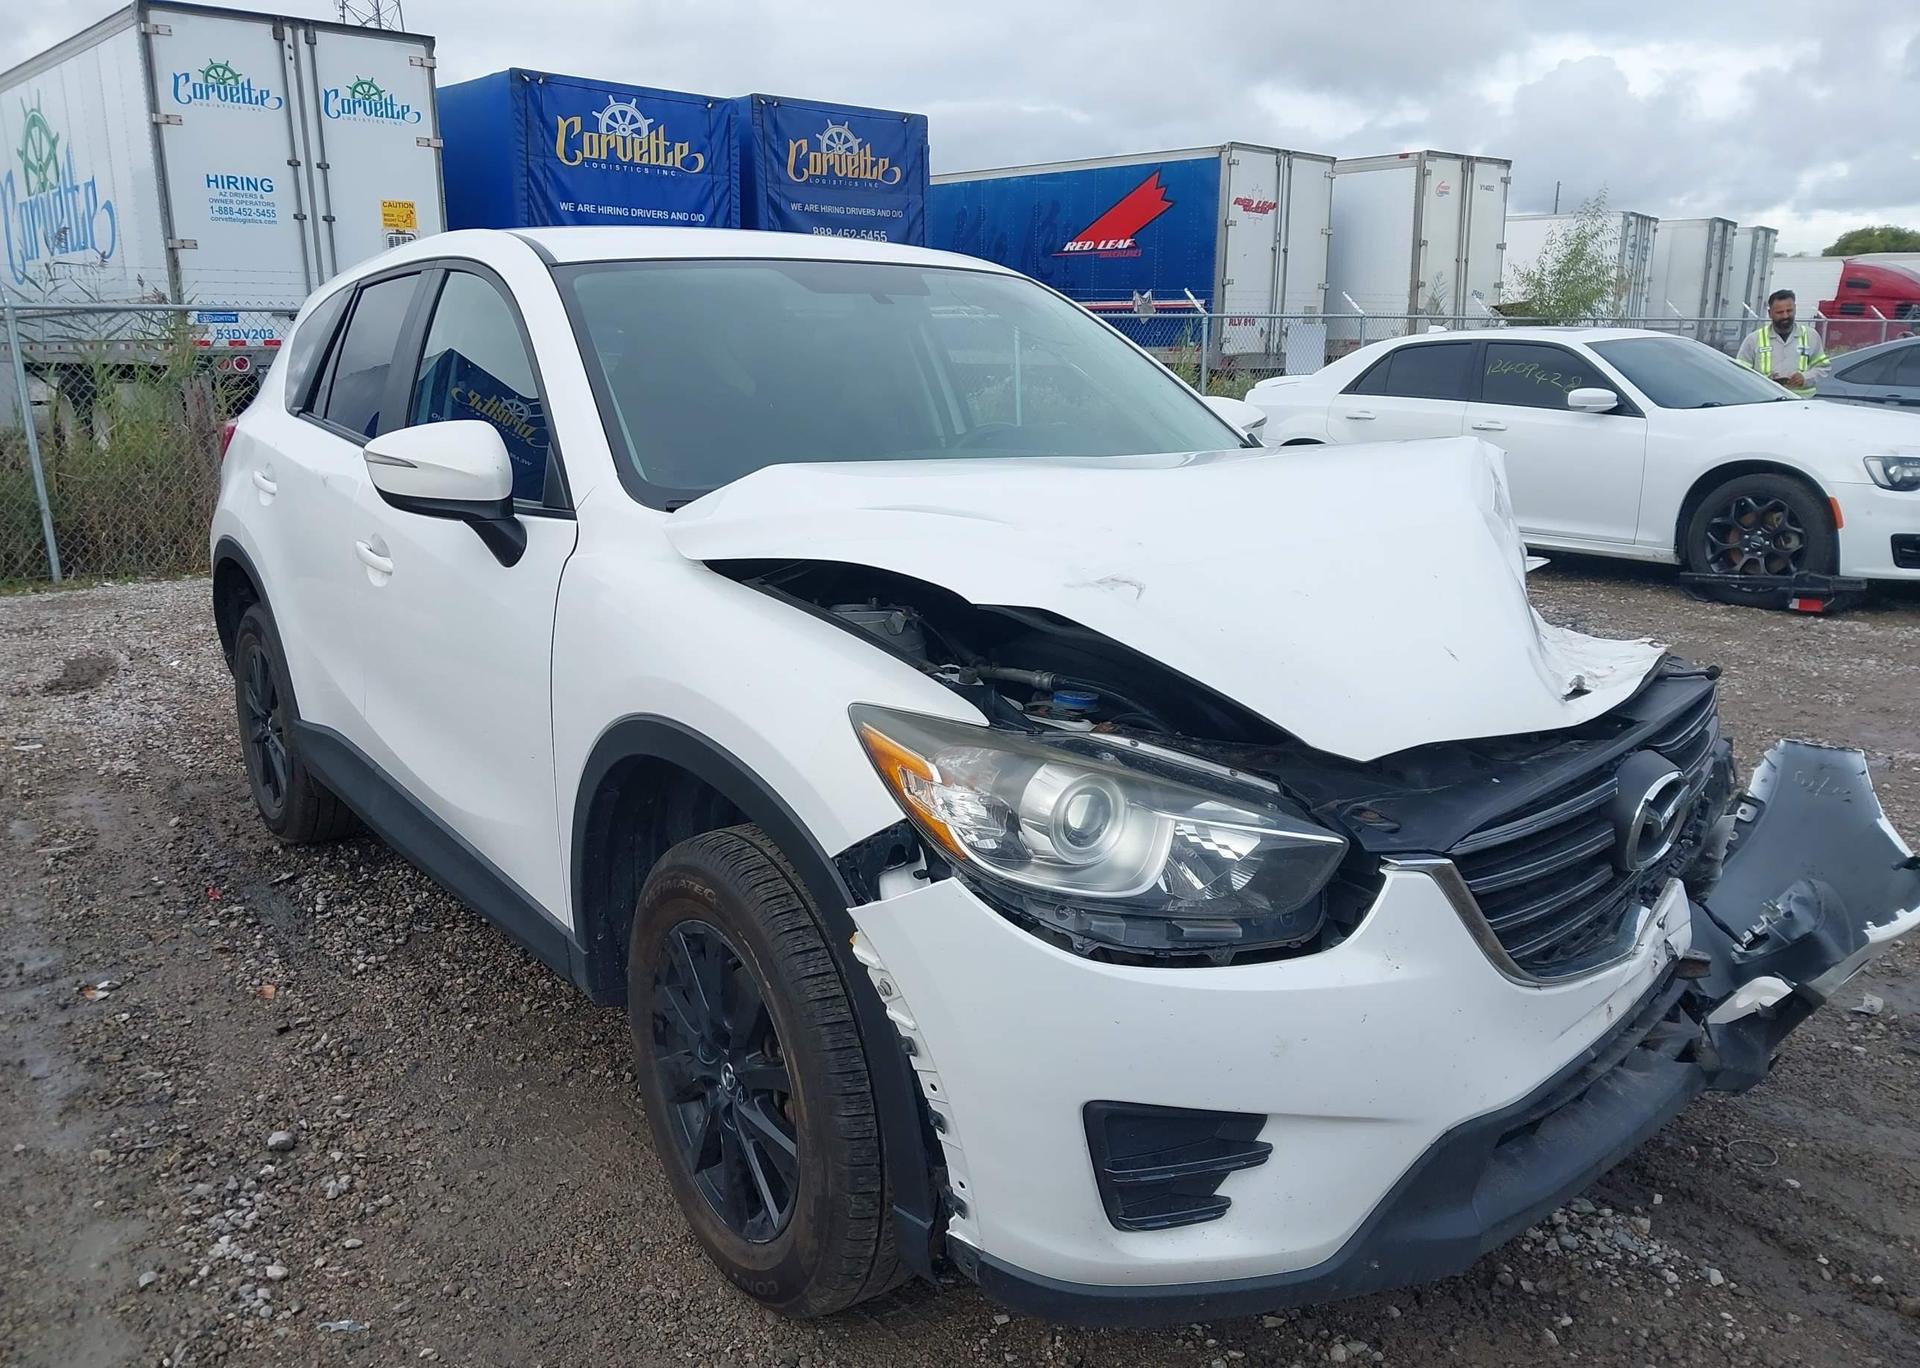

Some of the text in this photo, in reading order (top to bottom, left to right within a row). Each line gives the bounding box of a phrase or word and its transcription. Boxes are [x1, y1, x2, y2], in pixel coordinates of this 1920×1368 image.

[173, 72, 283, 110] Corvette
[324, 88, 421, 124] Corvette
[556, 115, 704, 173] Corvette
[584, 161, 650, 175] LOGISTICS
[787, 138, 901, 185] Corvette
[206, 173, 275, 193] HIRING
[809, 177, 859, 187] LOGISTICS
[208, 197, 276, 208] OWNER OPERATORS
[229, 192, 259, 200] DRIVERS
[210, 205, 277, 219] 1-888-452-5455
[382, 201, 414, 209] CAUTION
[559, 201, 705, 222] WE ARE HIRING DRIVERS AND O/O
[791, 202, 803, 211] WE
[804, 203, 819, 213] ARE
[820, 205, 845, 215] HIRING
[846, 207, 876, 217] DRIVERS
[876, 208, 891, 218] AND
[210, 216, 278, 225] corvettelogistics.com
[1063, 238, 1135, 251] RED LEAF
[1228, 318, 1242, 327] RLV
